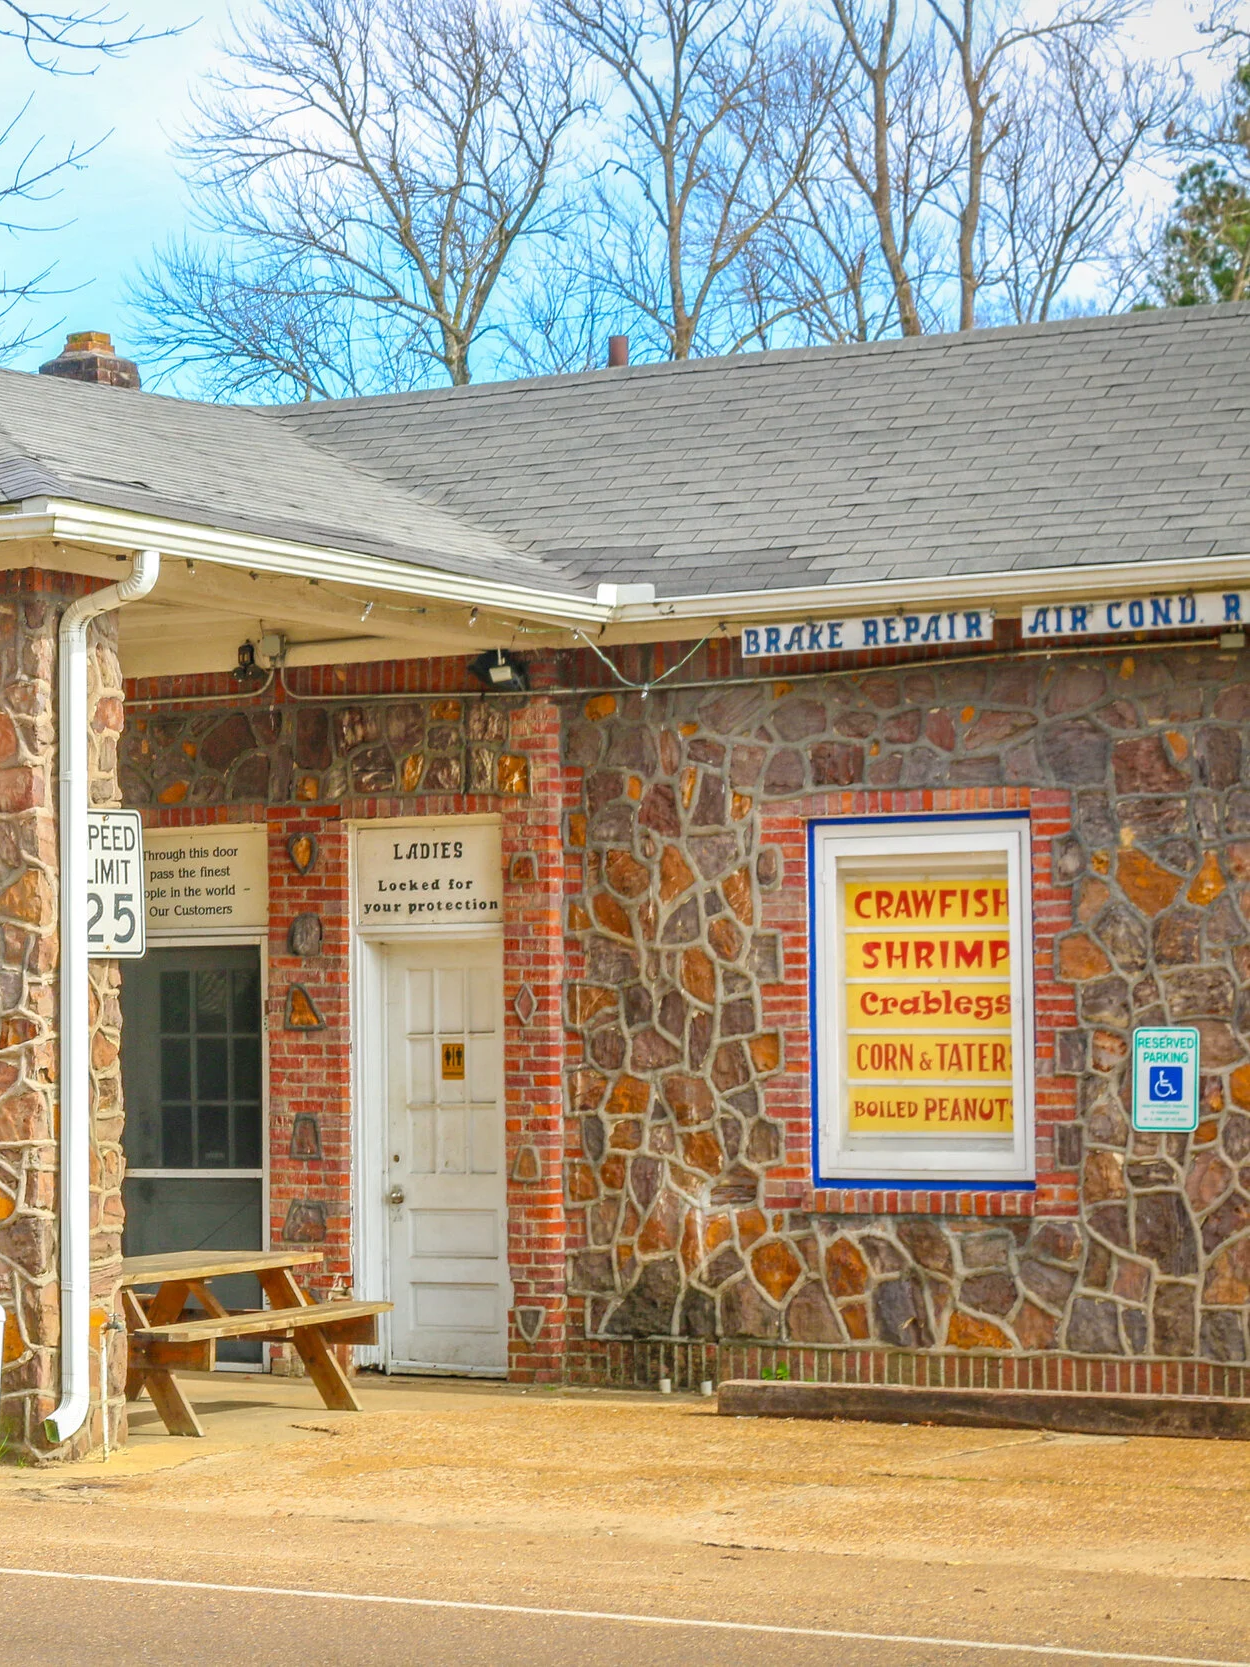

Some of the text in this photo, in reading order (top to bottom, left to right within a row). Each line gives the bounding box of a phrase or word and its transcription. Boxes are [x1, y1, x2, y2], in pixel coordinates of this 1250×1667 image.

[1028, 606, 1088, 634] AIR
[1107, 597, 1204, 629] COND.
[744, 612, 983, 656] BRAKE REPAIR
[87, 824, 135, 851] PEED
[144, 846, 238, 862] Through this door
[393, 841, 463, 860] LADIES
[87, 859, 131, 884] IMIT
[150, 866, 230, 882] pass the finest
[144, 887, 167, 900] ople
[170, 886, 180, 898] in
[184, 886, 201, 897] the
[205, 884, 236, 896] world
[378, 878, 473, 892] Locked for
[149, 904, 233, 917] Our Customers
[364, 898, 498, 914] your protection
[854, 888, 1009, 919] CRAWFISH
[87, 892, 136, 944] 25
[862, 939, 1010, 970] SHRIMP
[860, 989, 1011, 1020] Crablegs
[1137, 1037, 1195, 1049] RESERVED
[857, 1042, 1013, 1073] CORN & TATER
[1143, 1052, 1189, 1064] PARKING
[854, 1097, 1014, 1122] BOILED PEANUT
